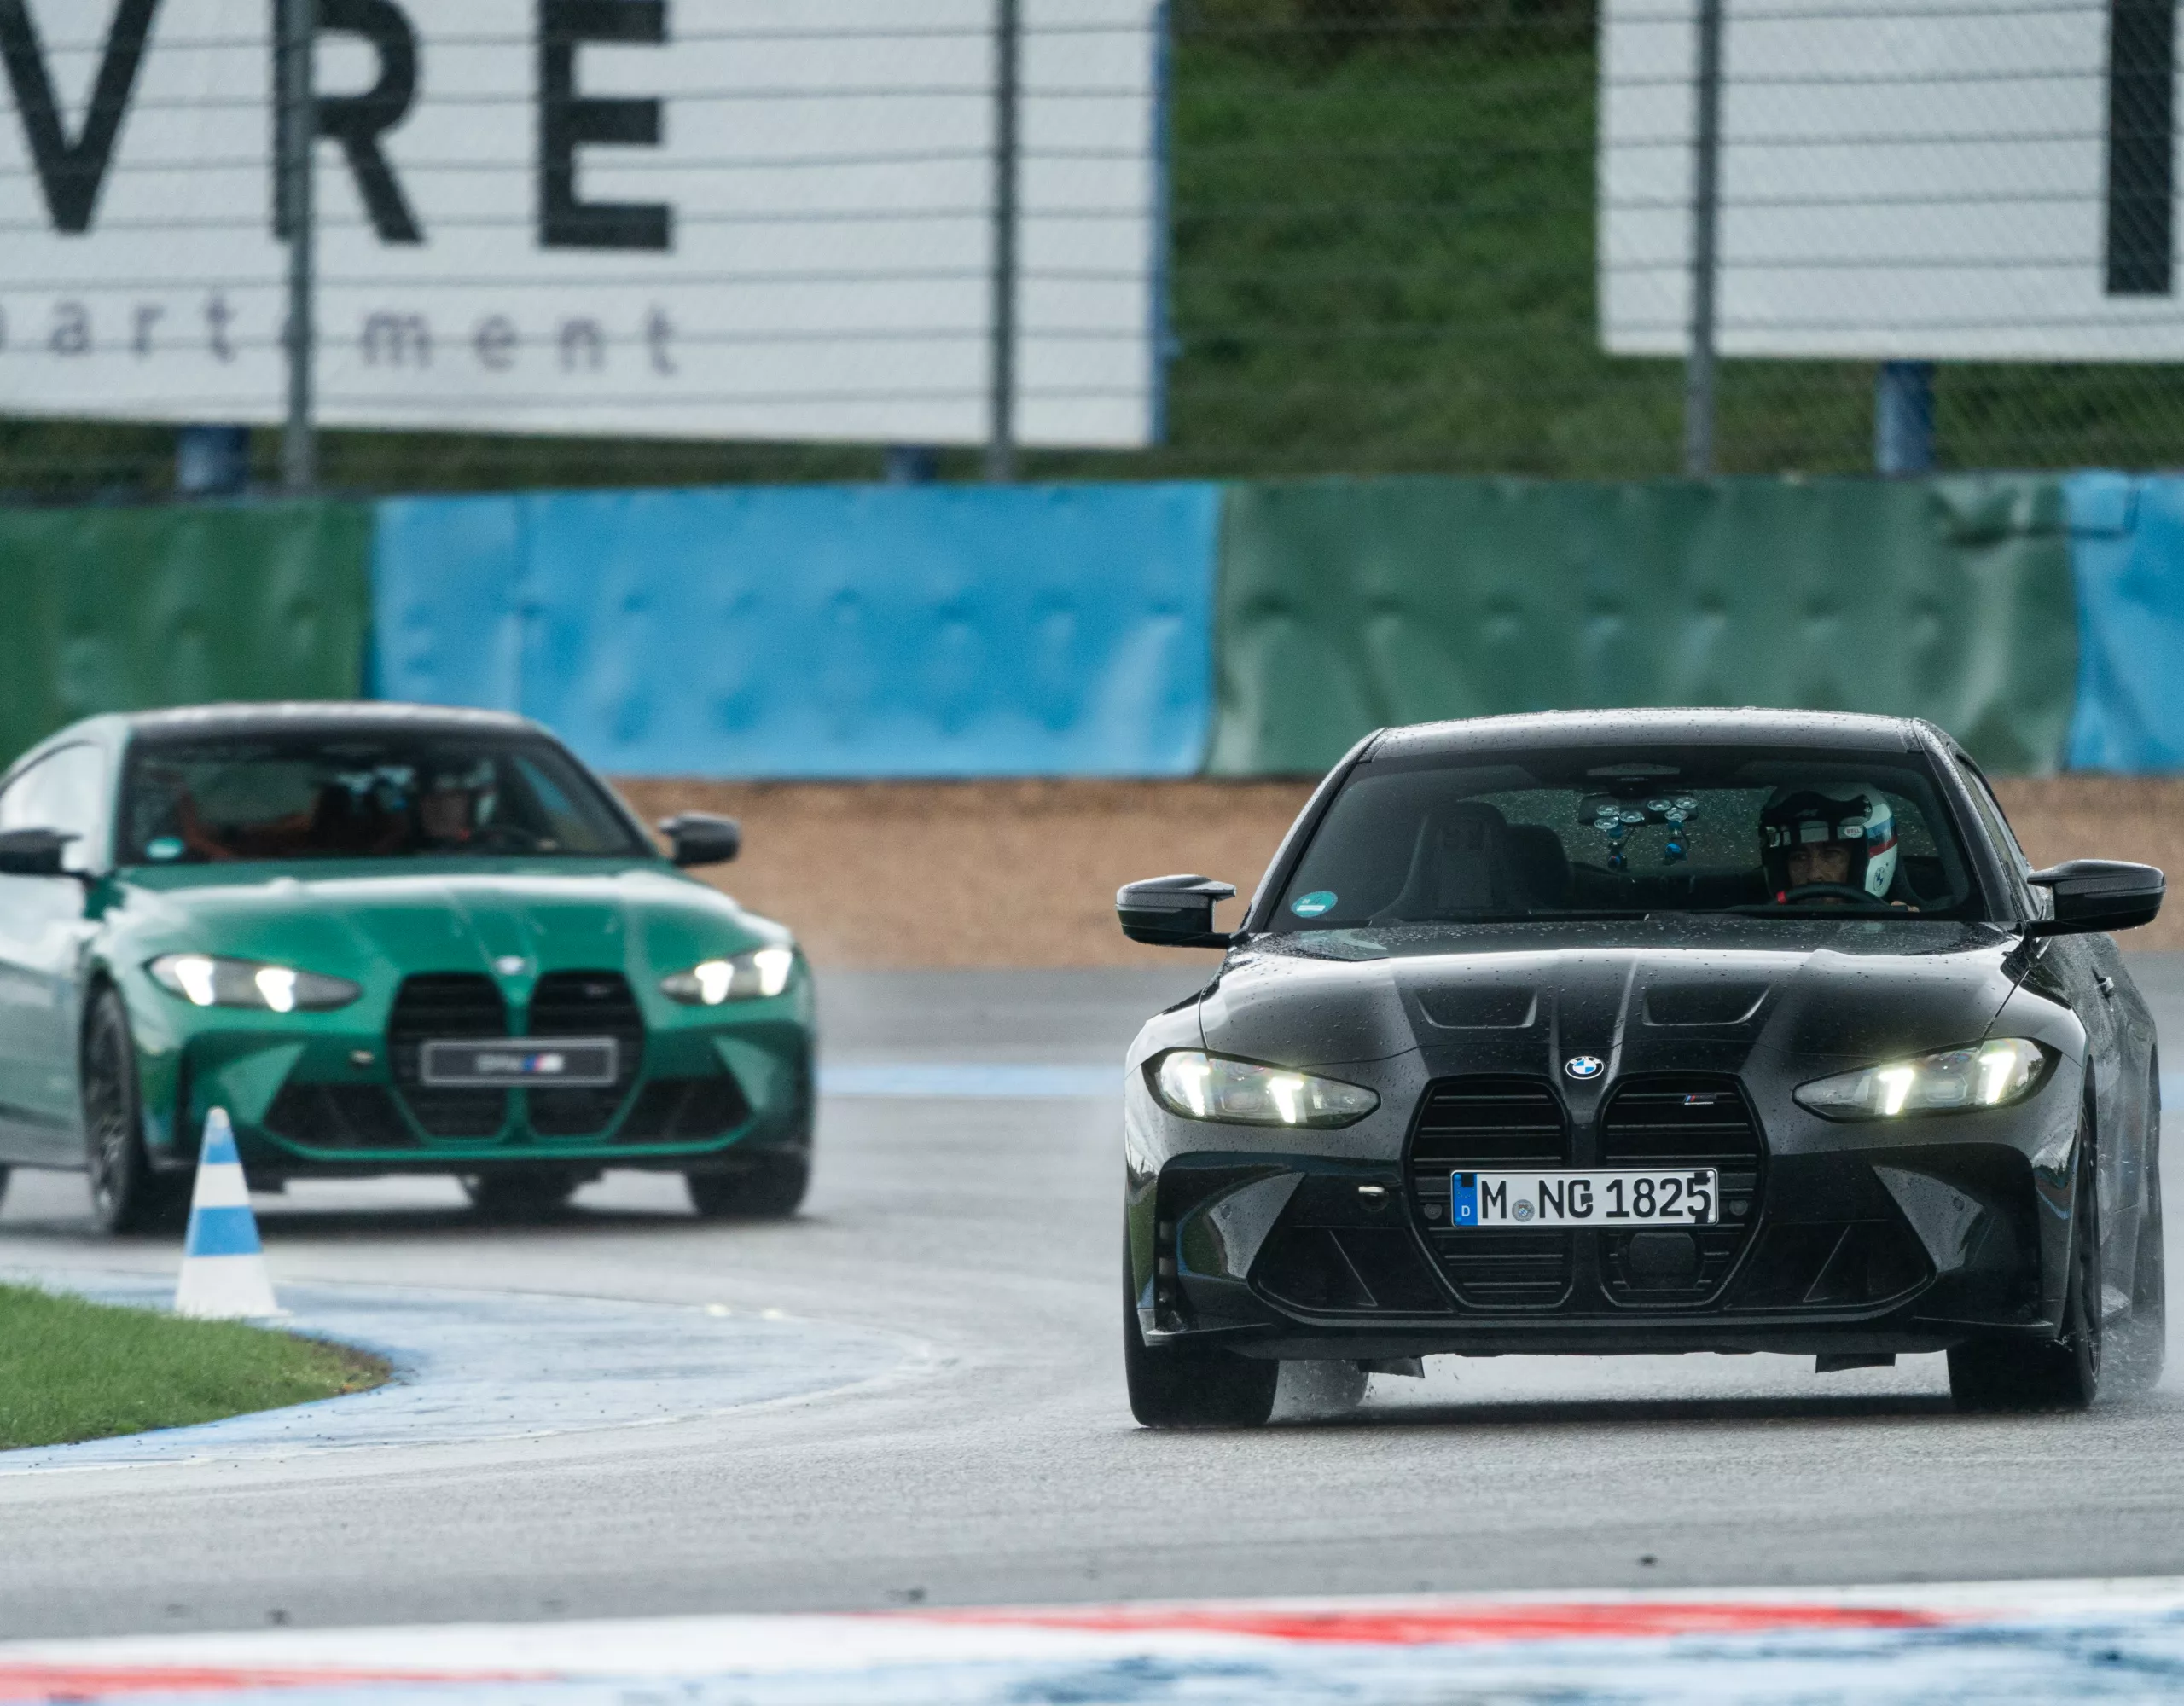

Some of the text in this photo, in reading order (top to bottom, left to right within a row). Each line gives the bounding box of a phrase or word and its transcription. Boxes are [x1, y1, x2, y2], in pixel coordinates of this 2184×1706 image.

[0, 287, 679, 378] artment
[1461, 1205, 1471, 1217] D
[1481, 1180, 1507, 1219] M
[1606, 1177, 1711, 1218] 1825
